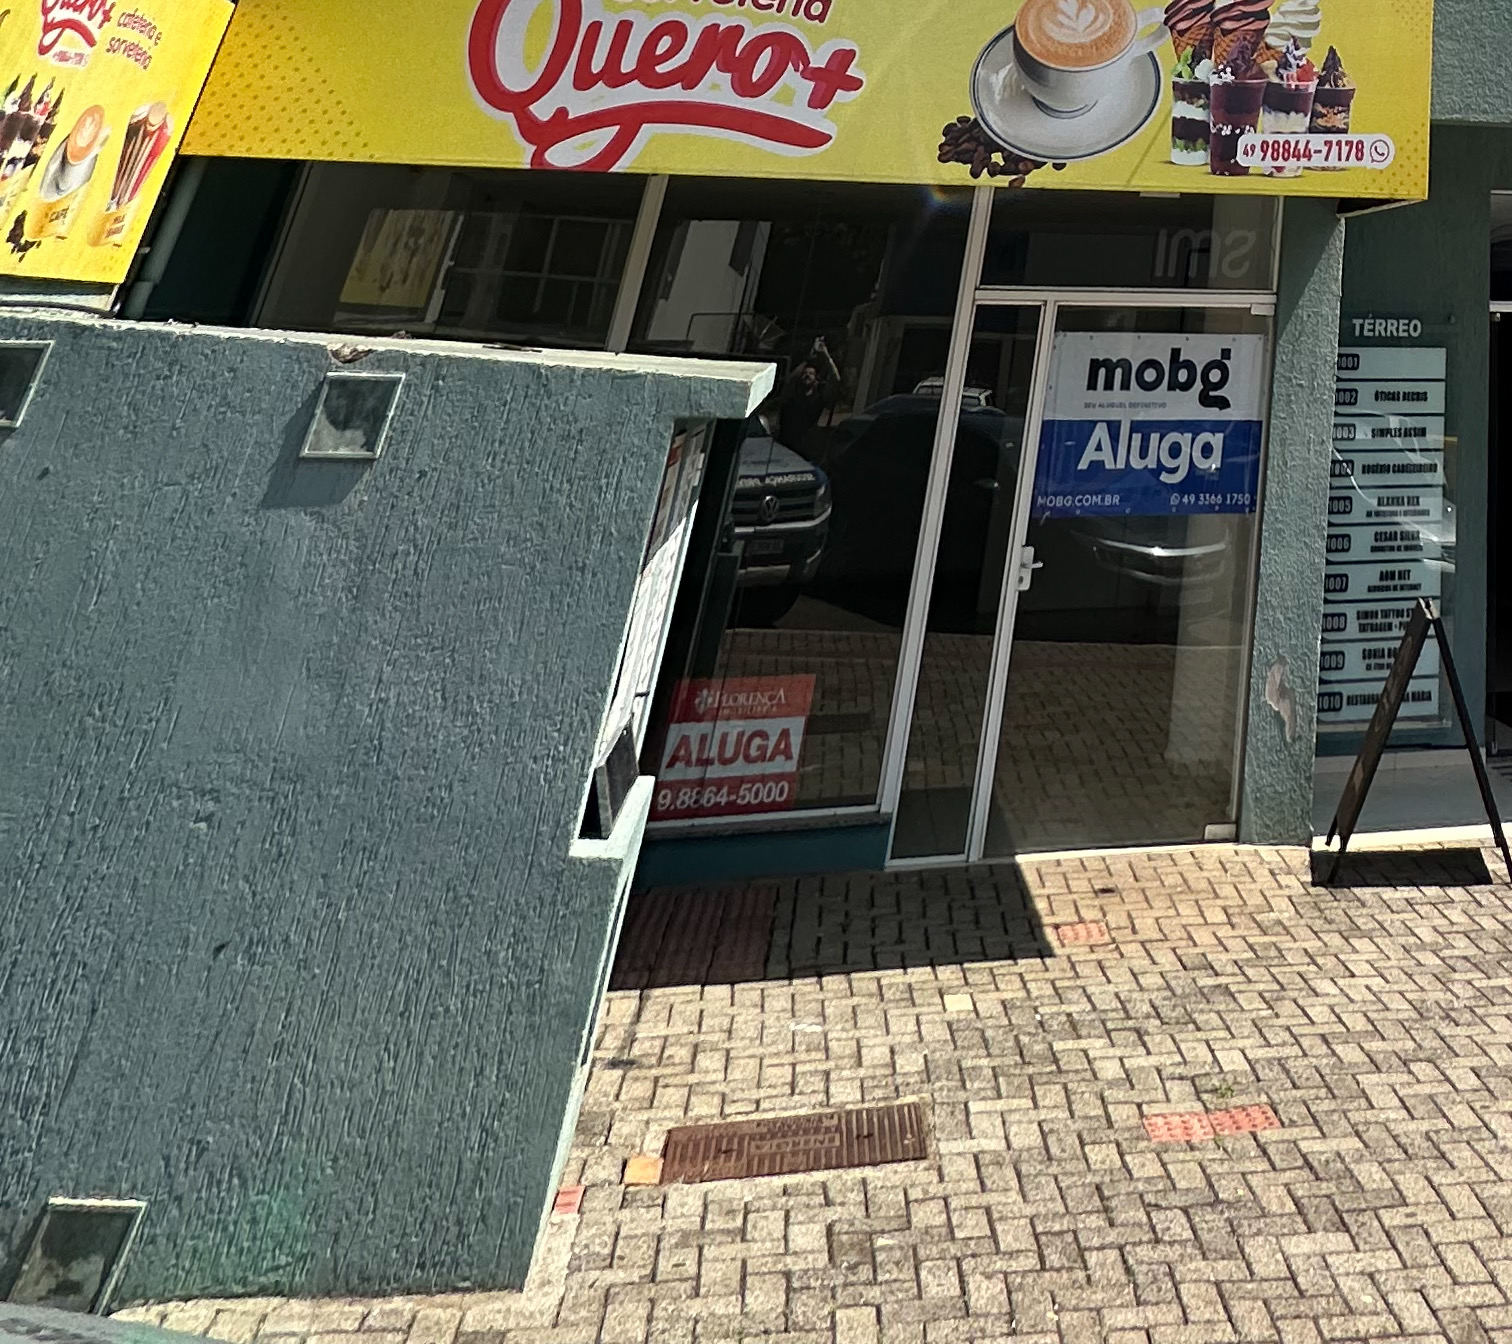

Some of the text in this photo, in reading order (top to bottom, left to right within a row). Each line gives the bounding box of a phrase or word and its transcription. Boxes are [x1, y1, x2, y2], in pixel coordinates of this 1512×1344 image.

[117, 7, 157, 40] cafeteria
[106, 37, 152, 70] sorveteria
[1243, 140, 1364, 162] 49 98844-7178
[1352, 314, 1422, 337] TÉRREO
[1086, 348, 1231, 410] mobg
[1077, 420, 1225, 484] Aluga
[1037, 494, 1250, 507] MOBG.COM.BR 49 3366 1750
[1324, 576, 1346, 590] 1007
[1322, 616, 1345, 629] 1008
[1321, 655, 1343, 668] 1009
[1318, 695, 1340, 708] 1010
[1347, 694, 1380, 706] RESTAURA
[664, 727, 793, 769] ALUGA
